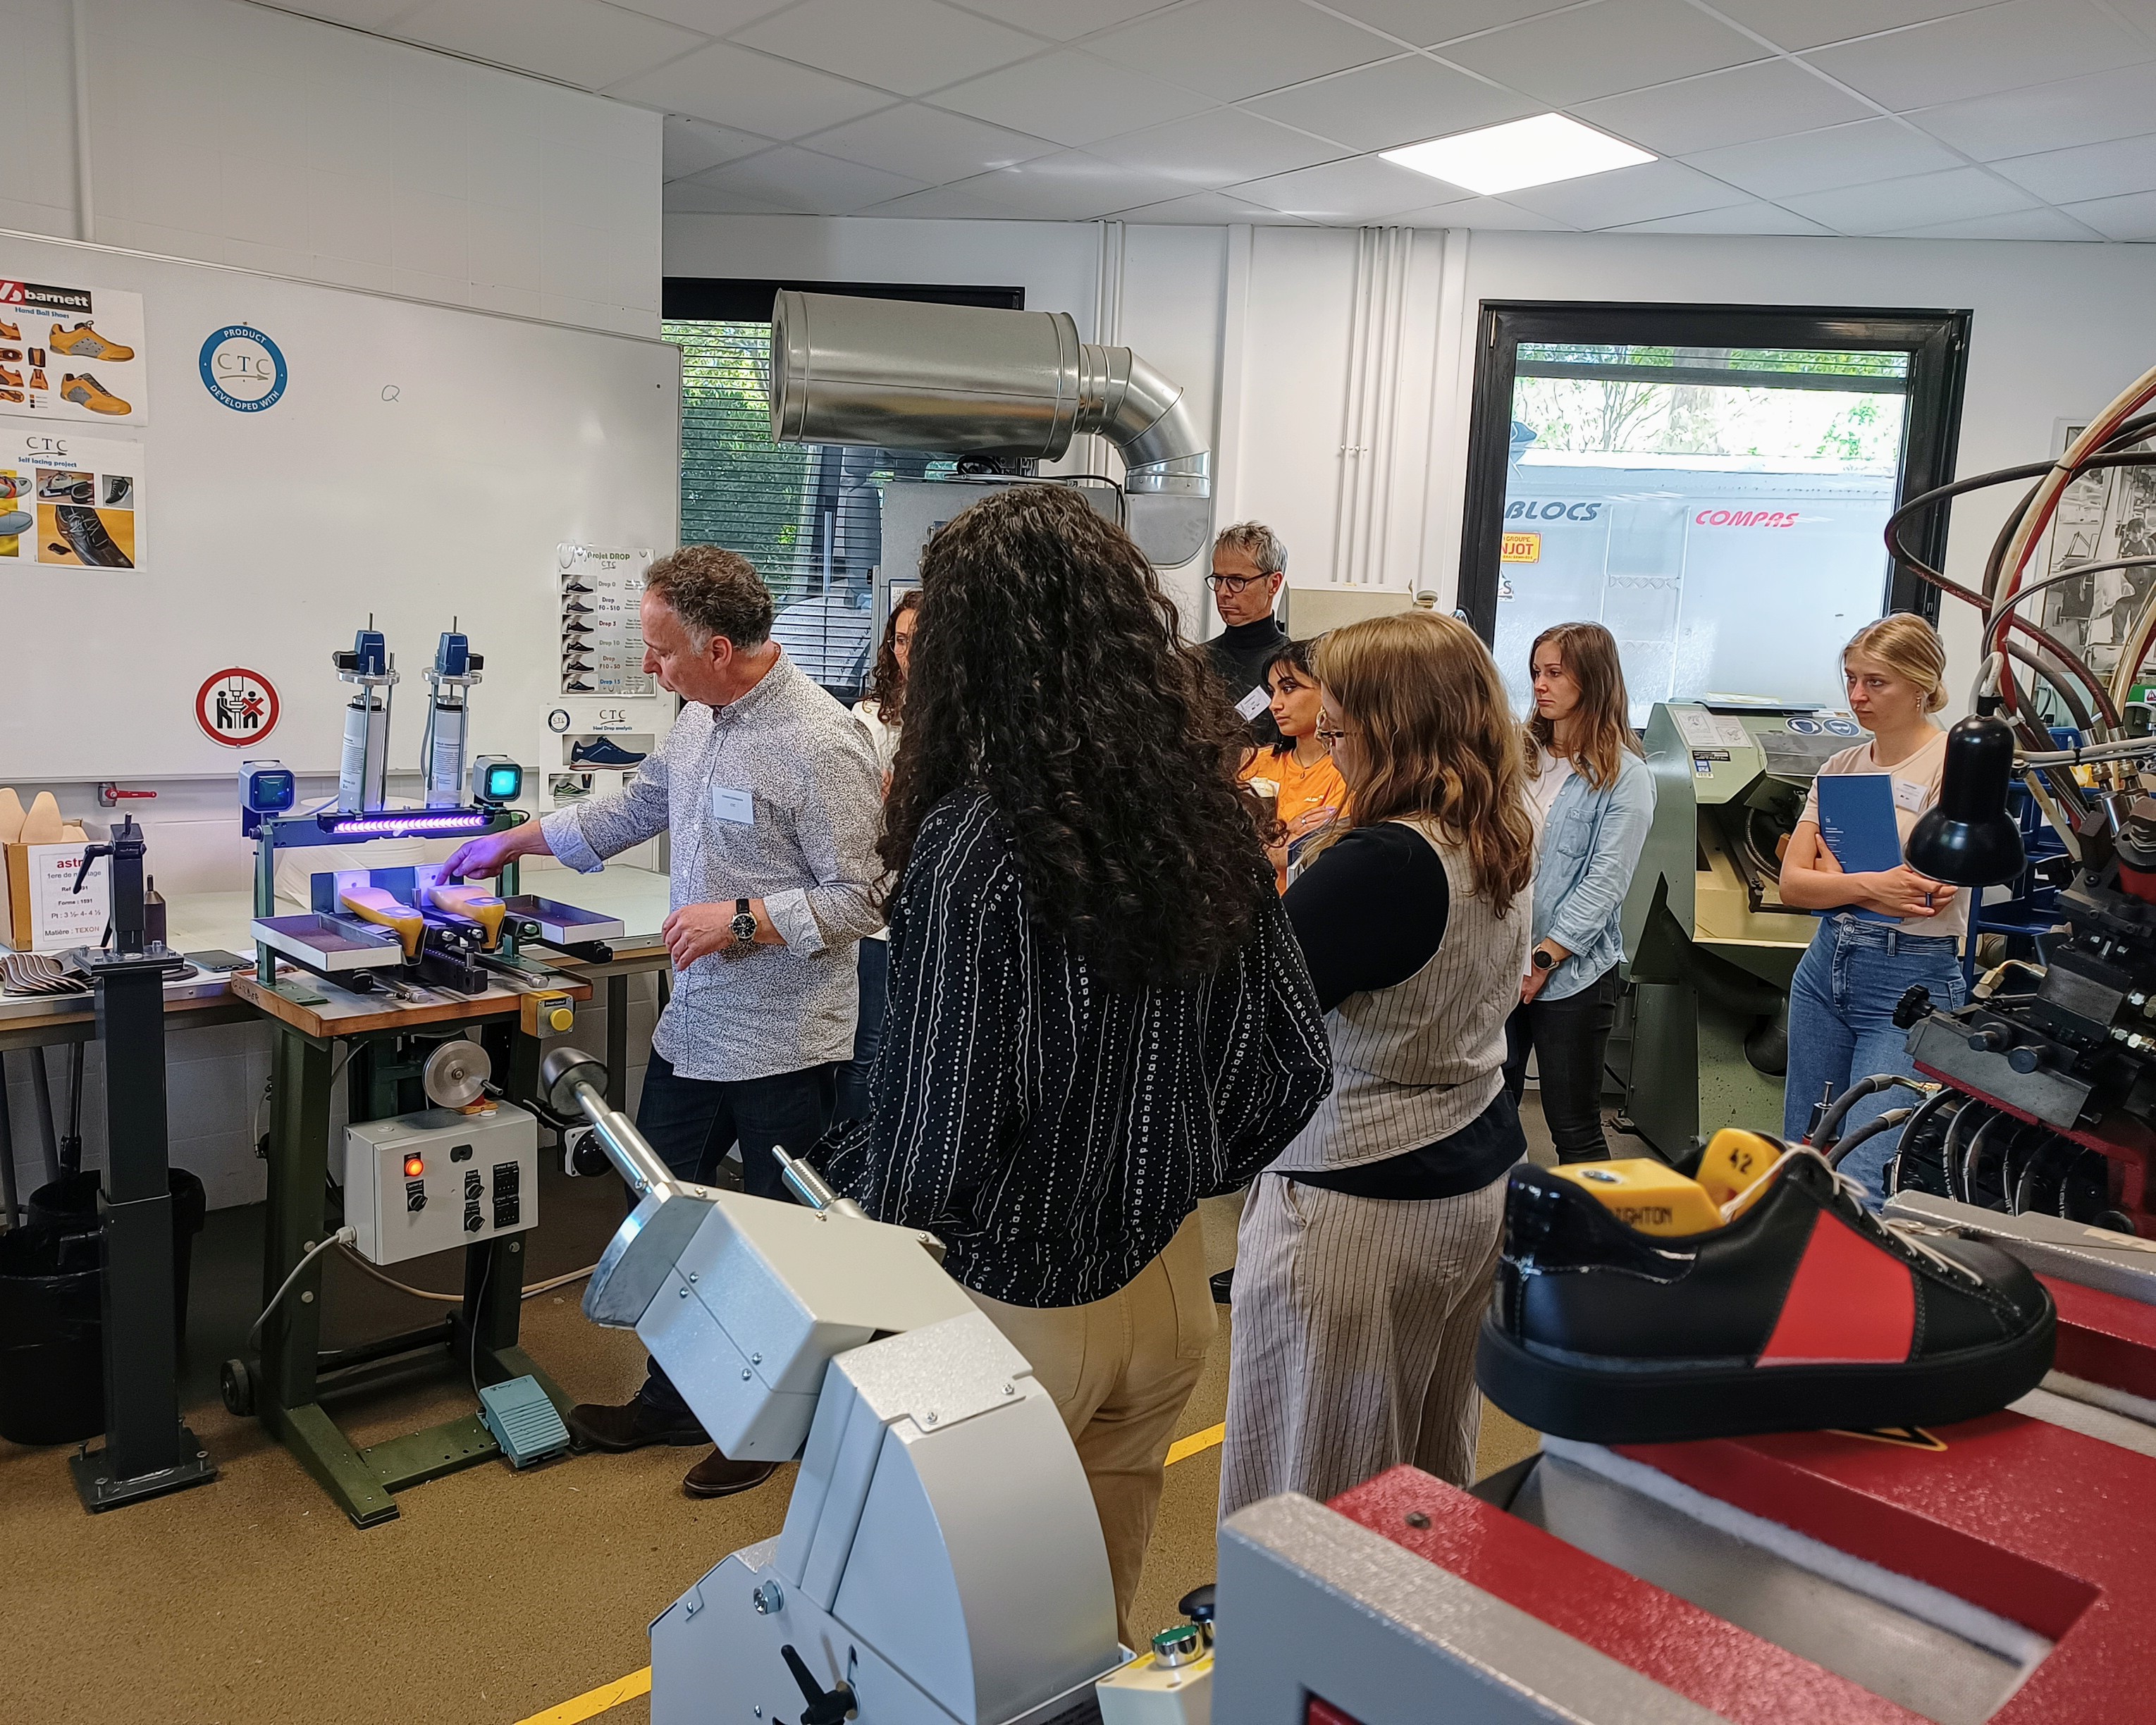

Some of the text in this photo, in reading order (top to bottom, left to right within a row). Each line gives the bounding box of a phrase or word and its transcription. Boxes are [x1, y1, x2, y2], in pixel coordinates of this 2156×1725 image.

[24, 289, 89, 307] barnett
[15, 307, 35, 315] Hand
[37, 309, 50, 317] Ball
[223, 328, 266, 344] PRODUCT
[210, 385, 280, 410] DEVELOPED WITH
[32, 458, 52, 466] lacing
[1505, 501, 1602, 521] BLOCS
[1695, 510, 1800, 528] COMPAS
[599, 709, 627, 719] CTC
[57, 858, 84, 868] astr
[75, 926, 99, 934] TEXON
[1728, 1147, 1754, 1175] 42
